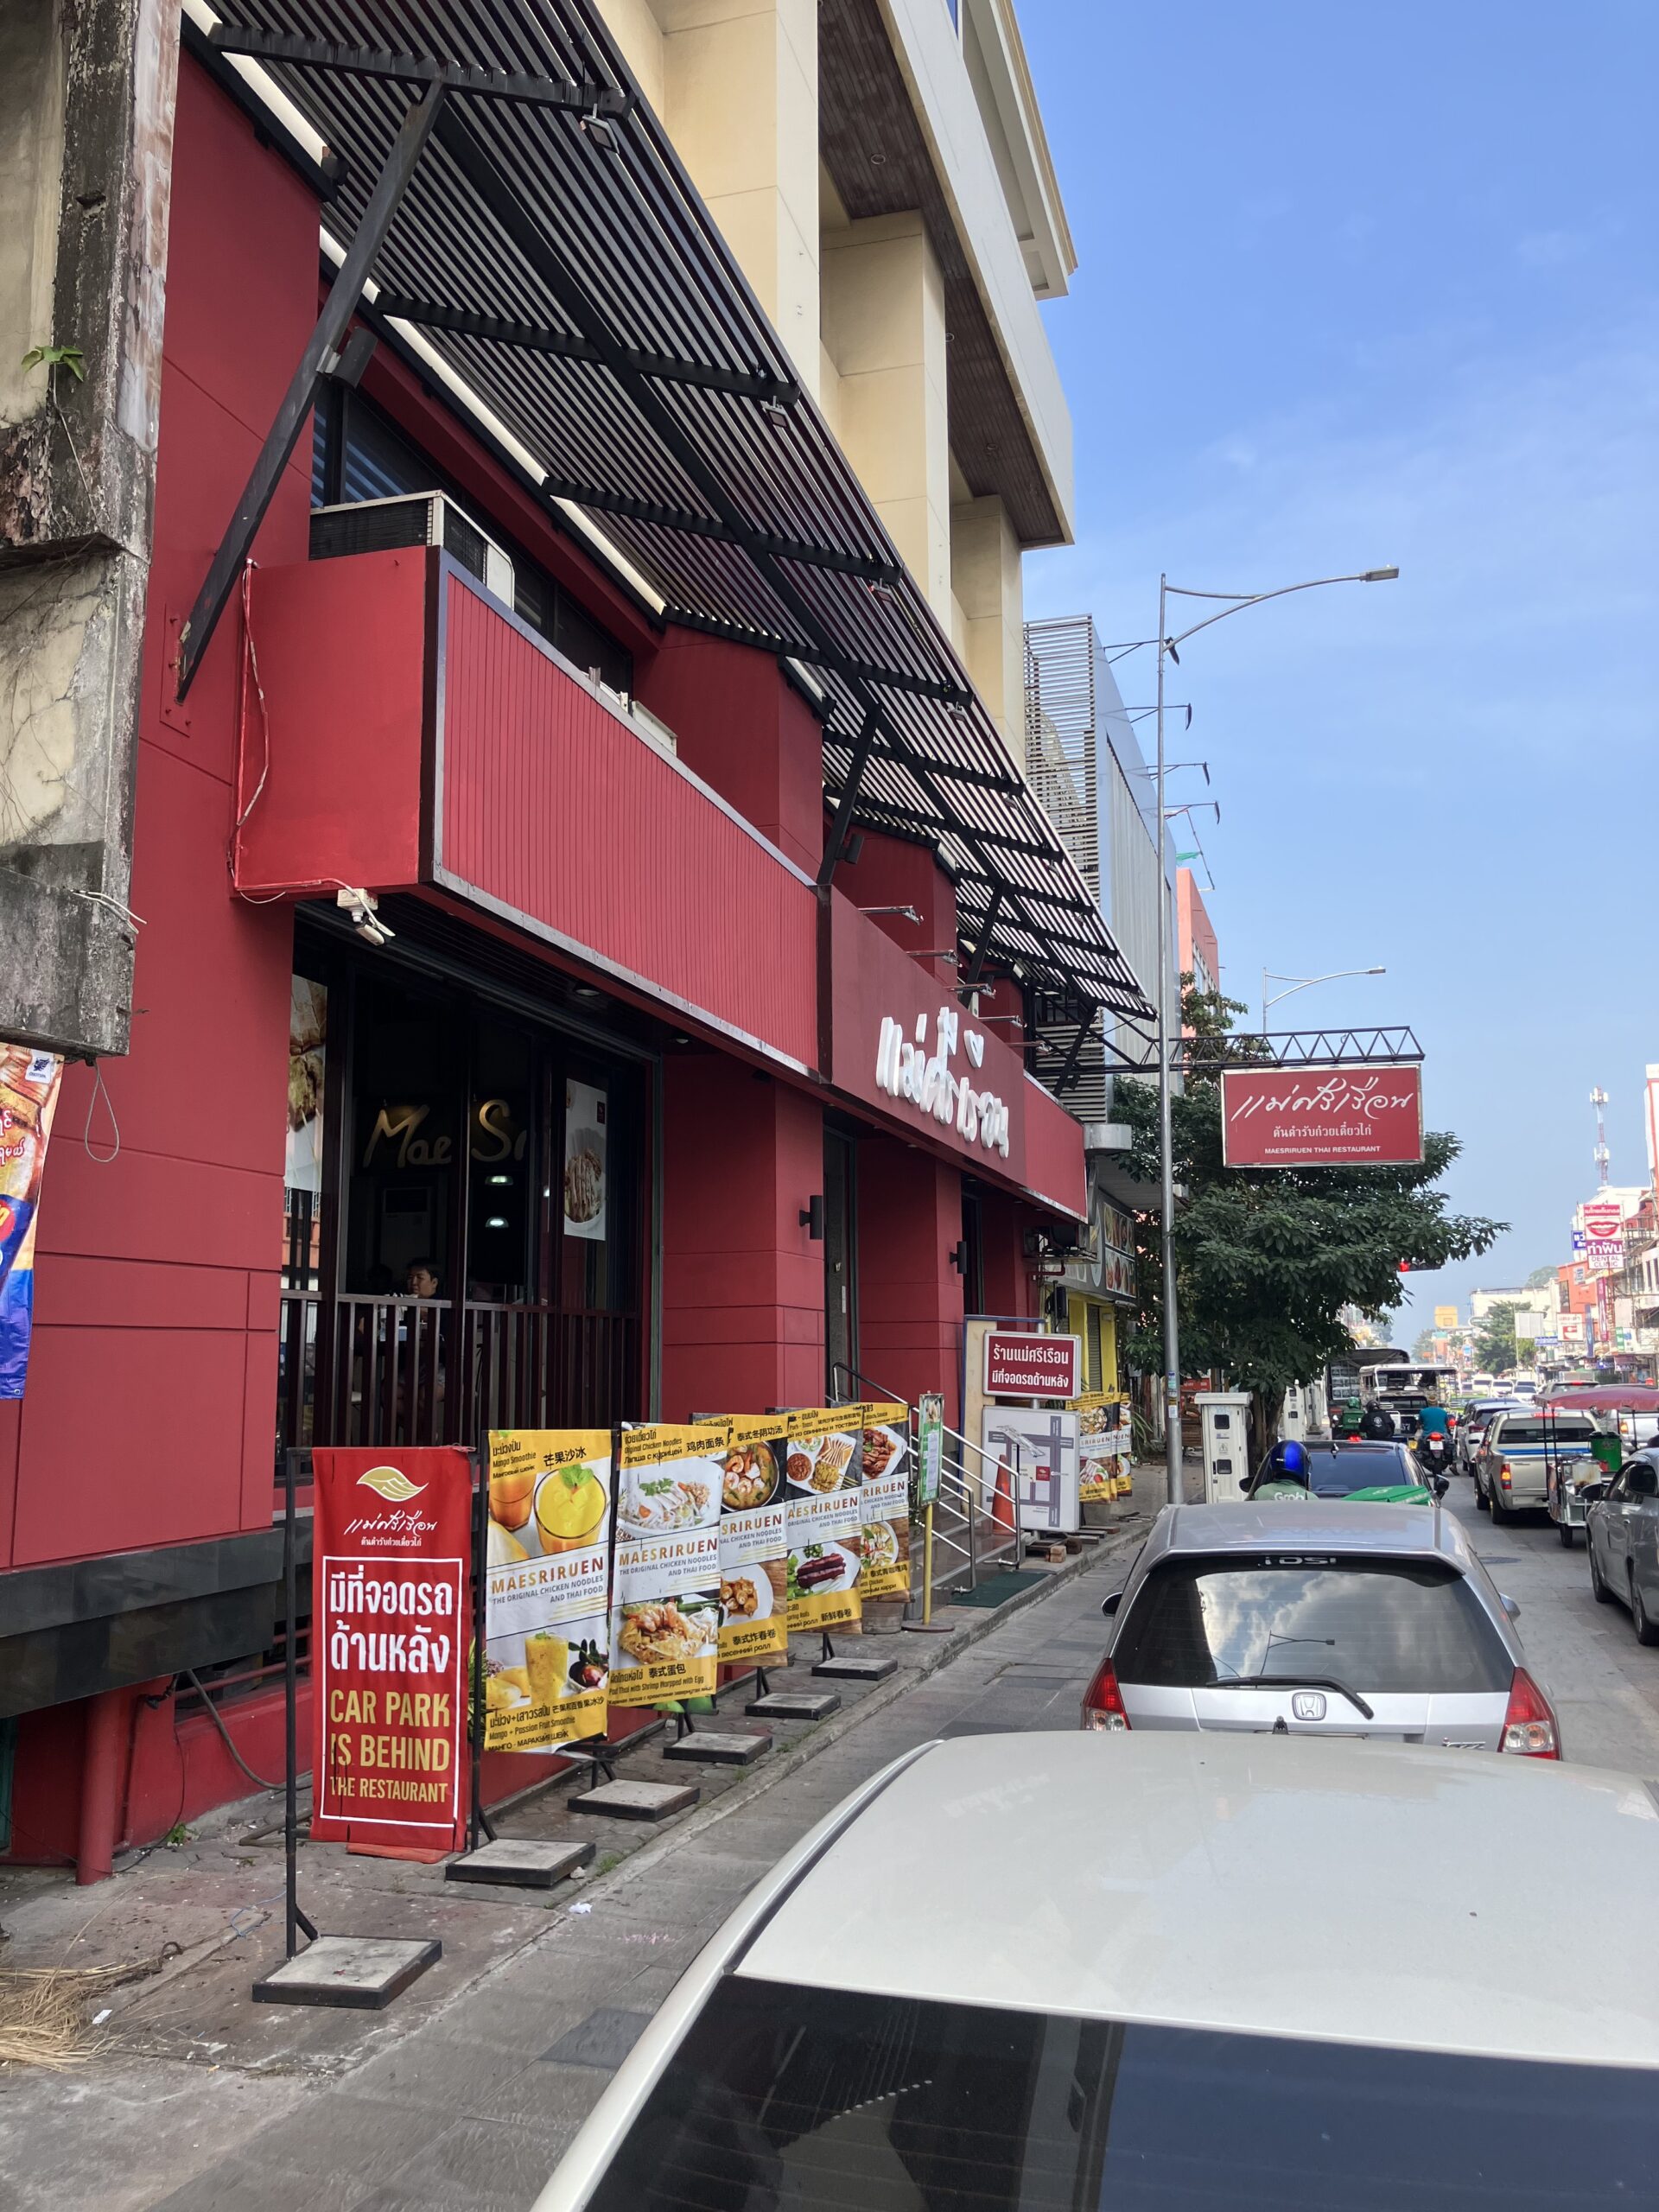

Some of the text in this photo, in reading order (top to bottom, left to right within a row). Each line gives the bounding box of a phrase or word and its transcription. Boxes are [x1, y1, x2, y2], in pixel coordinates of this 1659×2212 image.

[1230, 1077, 1414, 1121] แม่ศรีเรือน
[363, 1104, 452, 1168] Mae
[994, 1344, 1069, 1364] ร้านแม่ศรีเรือน
[992, 1368, 1069, 1388] มีที่จอดรถด้านหลัง
[686, 1436, 724, 1452] 鸡肉面条
[493, 1452, 536, 1468] Mango Smoothie
[543, 1446, 587, 1467] 芒果沙冰
[863, 1481, 905, 1497] RIRUEN
[788, 1497, 858, 1519] AESRIRUEN
[344, 1510, 437, 1536] แม่ศรีเรือน
[721, 1514, 782, 1535] SRIRUEN
[731, 1533, 755, 1542] CHICKEN
[756, 1528, 782, 1538] NOODLES
[619, 1538, 717, 1567] MAESRIRUEN
[631, 1564, 658, 1574] ORIGINAL
[660, 1560, 686, 1570] CHICKEN
[688, 1554, 716, 1565] NOODLES
[492, 1557, 603, 1594] MAESRIRUEN
[330, 1564, 453, 1615] มีที่จอดรถ
[507, 1590, 538, 1601] ORIGINAL
[540, 1583, 569, 1595] CHICKEN
[571, 1575, 603, 1587] NOODLES
[567, 1591, 582, 1600] THAI
[584, 1586, 603, 1596] FOOD
[331, 1619, 450, 1673] ด้านหลัง
[330, 1689, 450, 1727] CAR PARK
[489, 1731, 507, 1740] Mango
[331, 1733, 450, 1771] IS BEHIND
[330, 1777, 448, 1802] THE RESTAURANT
